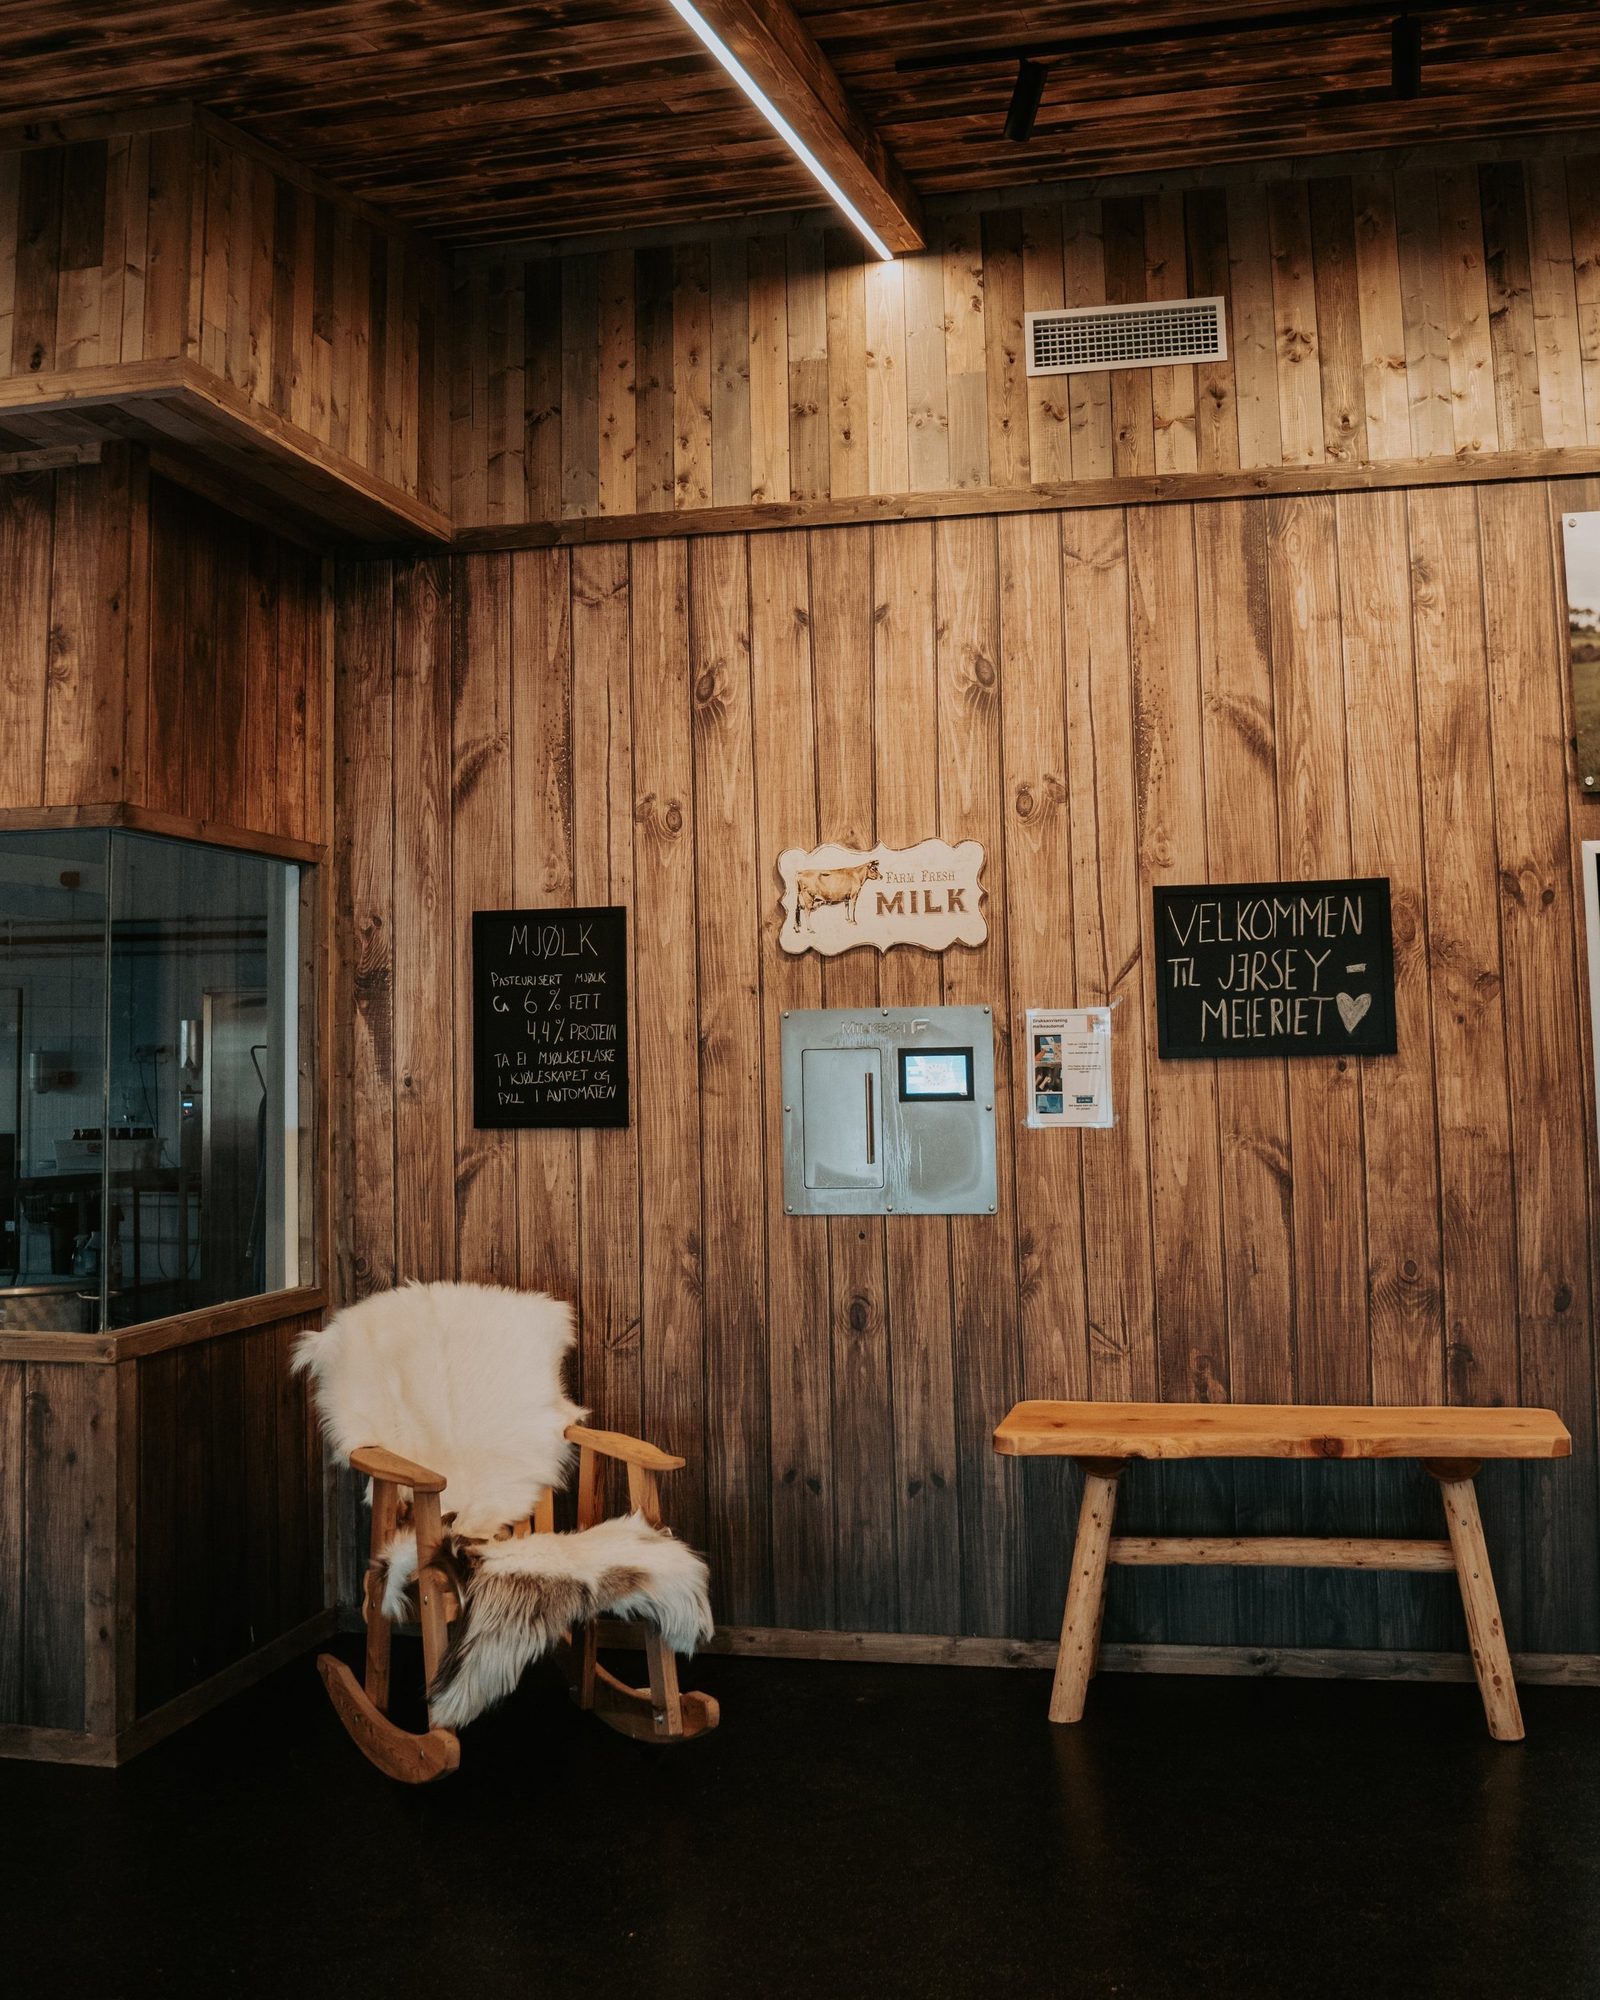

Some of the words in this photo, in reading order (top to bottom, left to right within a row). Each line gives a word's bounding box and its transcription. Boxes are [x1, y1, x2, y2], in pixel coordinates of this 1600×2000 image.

[875, 888, 967, 915] MILK
[1168, 896, 1363, 947] VELKOMMEN
[509, 923, 598, 960] MJØLK
[575, 972, 607, 984] MJØLK
[1218, 949, 1332, 992] JERSEY
[524, 989, 538, 1014] 6
[548, 988, 562, 1012] %
[569, 993, 600, 1010] FETT
[570, 1022, 617, 1041] PROTEIN
[1201, 996, 1335, 1043] MEIERIET
[494, 1053, 510, 1068] TA
[516, 1051, 528, 1066] EI
[538, 1048, 616, 1064] MJØLKEFLASKE
[510, 1069, 589, 1086] KJØLESKAPET
[594, 1069, 611, 1083] OG
[497, 1092, 525, 1106] FYLL
[546, 1084, 616, 1103] AUTOMATEN
